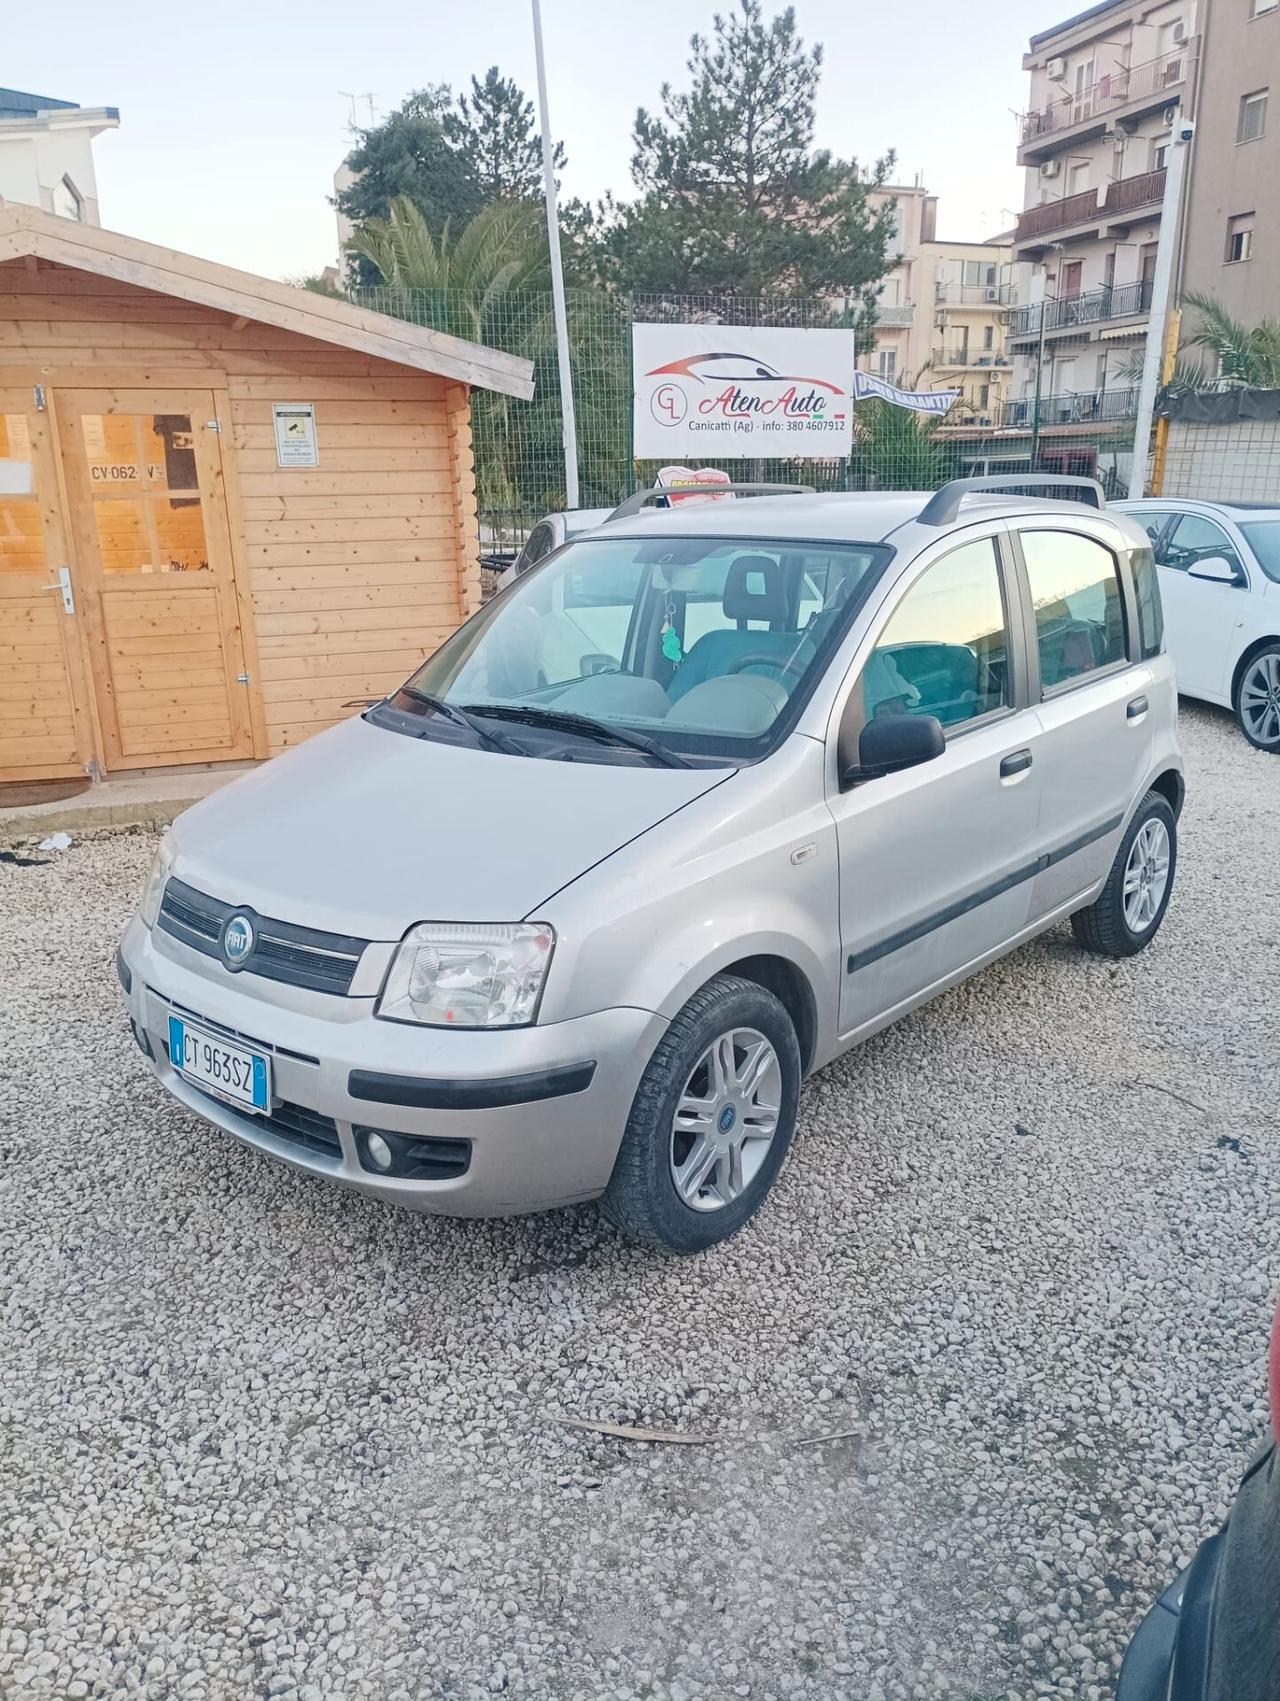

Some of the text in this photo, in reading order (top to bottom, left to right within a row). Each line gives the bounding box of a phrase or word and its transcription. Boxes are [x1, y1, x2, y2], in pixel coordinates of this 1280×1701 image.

[734, 420, 753, 433] (Ag)
[762, 420, 784, 431] info:
[786, 421, 804, 431] 380
[805, 420, 845, 431] 4607912
[227, 931, 246, 949] FIAT
[184, 1034, 199, 1067] CT
[203, 1044, 252, 1094] 963SZ
